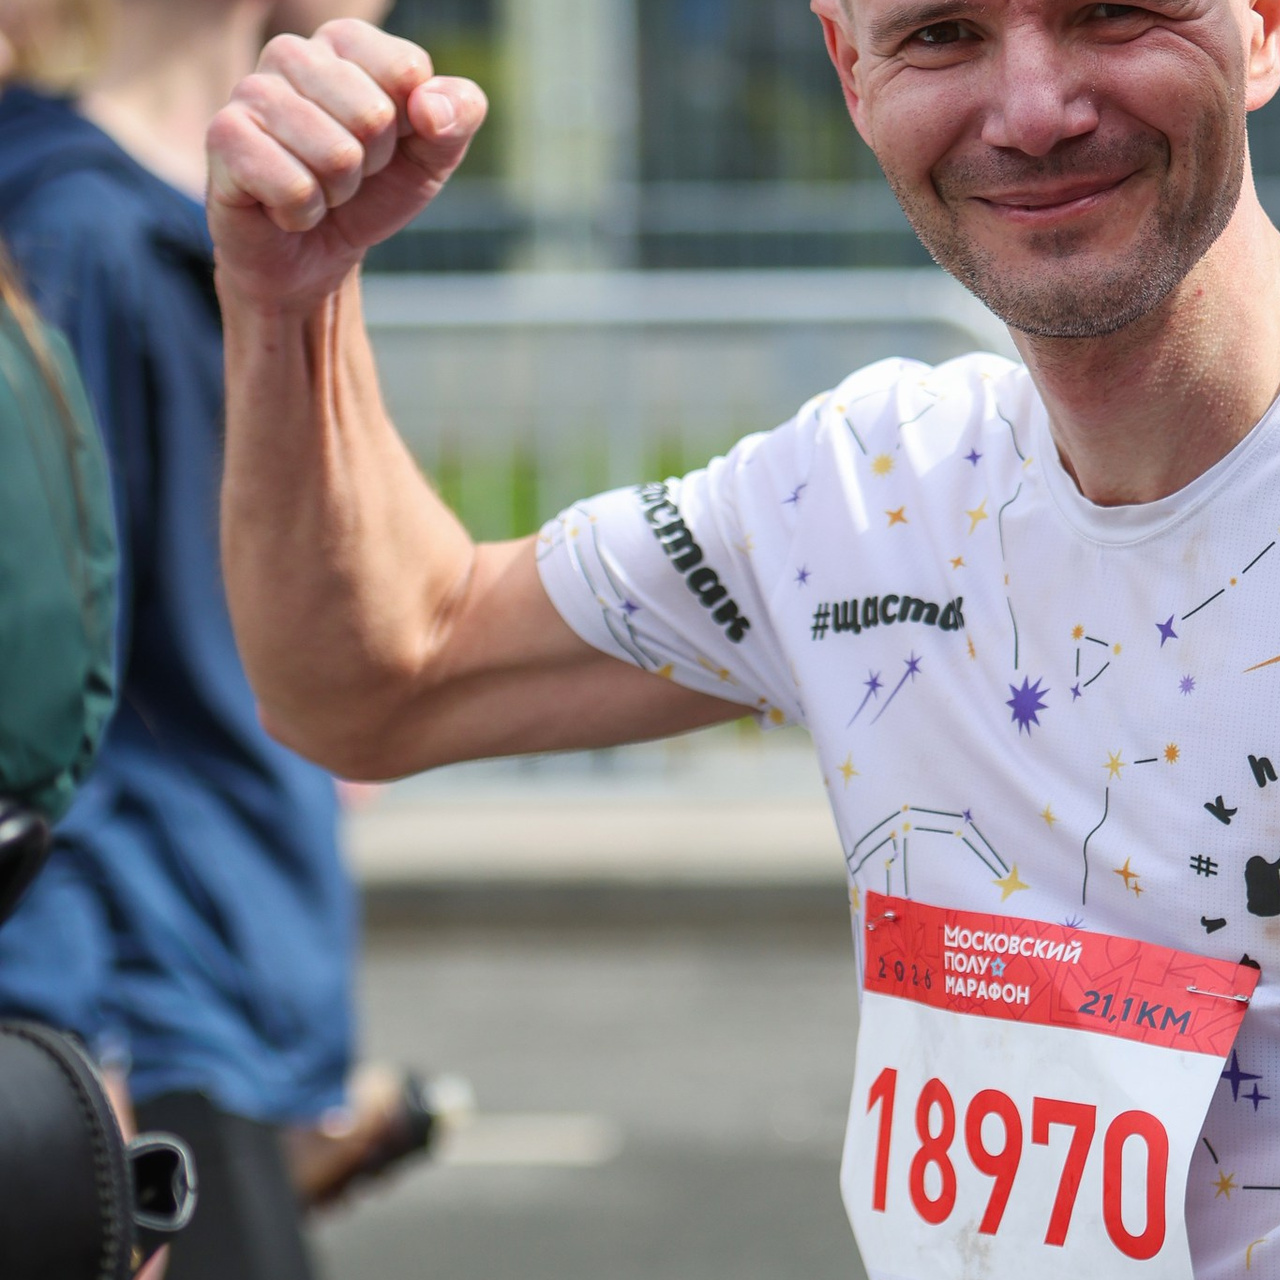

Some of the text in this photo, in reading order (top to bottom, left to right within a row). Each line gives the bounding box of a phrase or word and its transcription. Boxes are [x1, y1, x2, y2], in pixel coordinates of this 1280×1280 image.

[944, 925, 1083, 965] МОСКОВСКИЙ
[944, 951, 990, 976] ПОЛУ
[945, 976, 1030, 1006] МАРАФОН
[866, 1067, 1169, 1261] 18970
